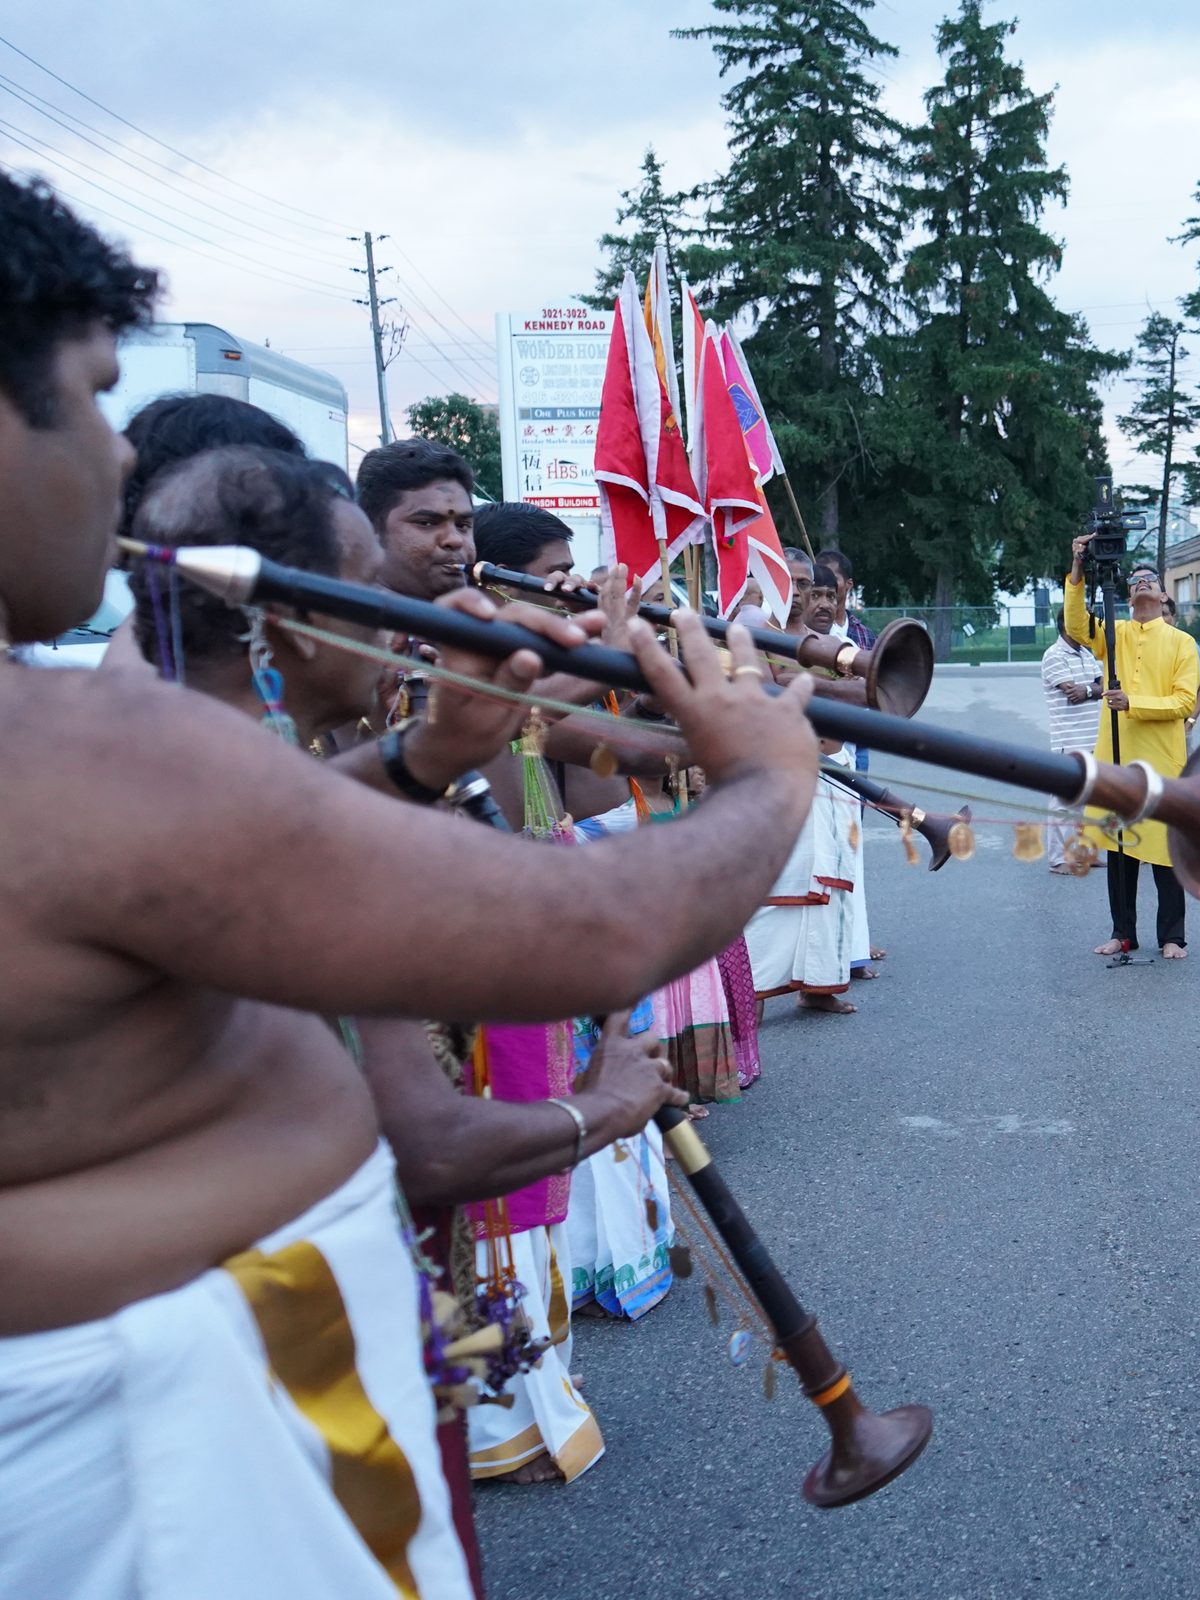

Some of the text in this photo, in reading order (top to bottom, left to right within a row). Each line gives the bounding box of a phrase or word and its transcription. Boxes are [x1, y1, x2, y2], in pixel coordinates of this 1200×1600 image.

[542, 309, 587, 319] 3021-3025
[524, 321, 606, 330] KENNEDY ROAD
[518, 342, 574, 360] WONDER
[557, 408, 576, 417] PLUS
[547, 458, 578, 479] HBS
[558, 498, 593, 507] BUILDING
